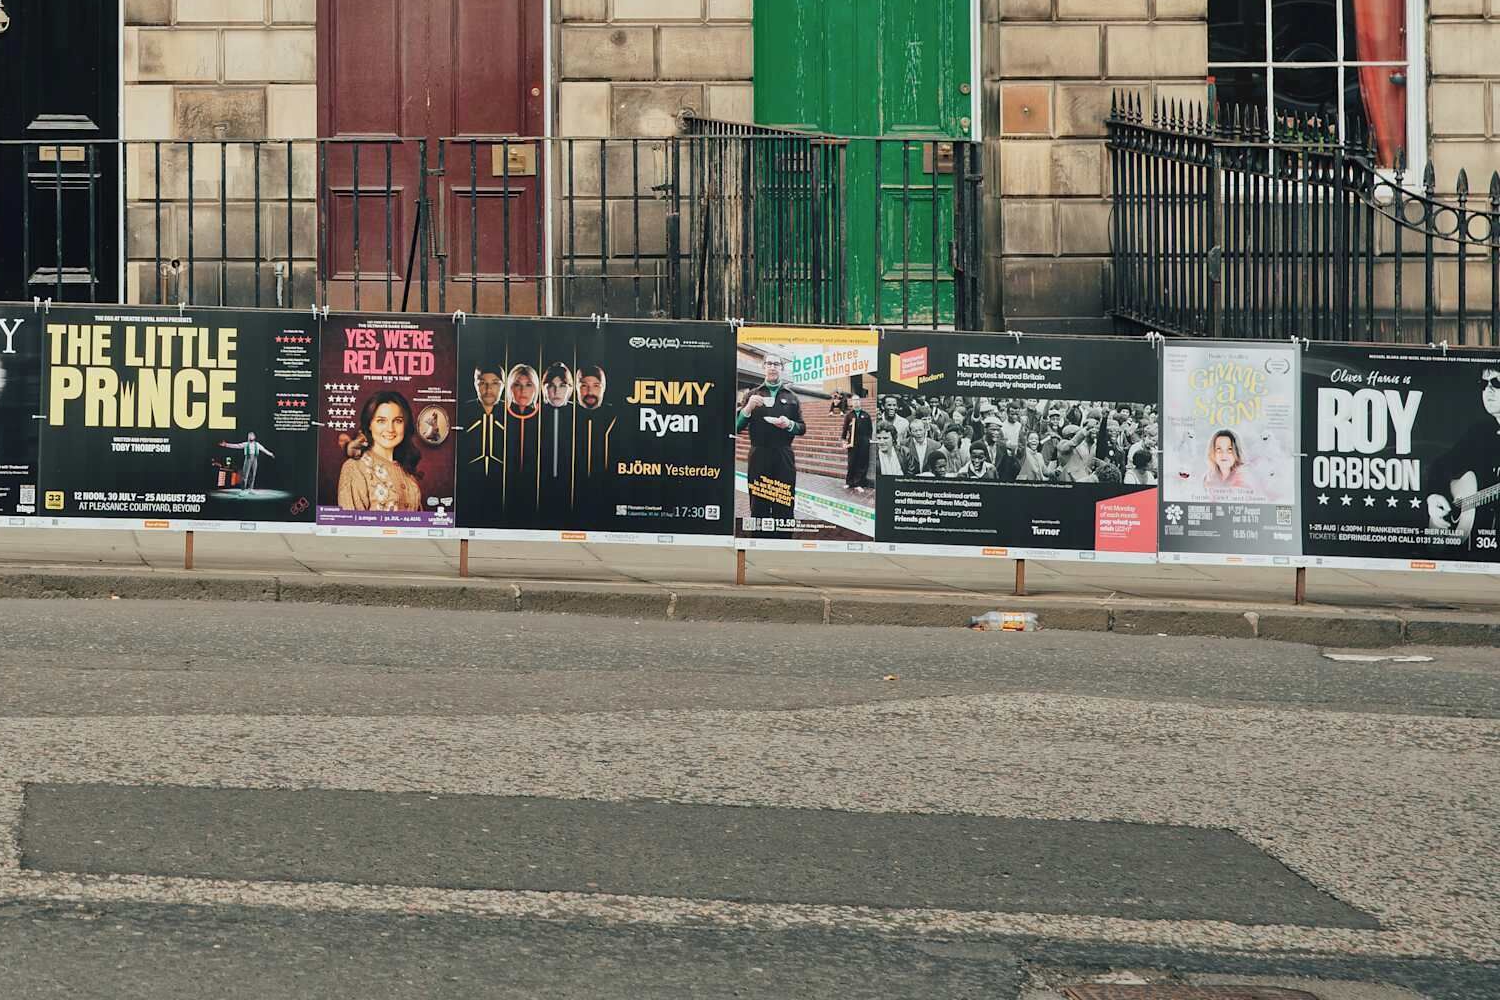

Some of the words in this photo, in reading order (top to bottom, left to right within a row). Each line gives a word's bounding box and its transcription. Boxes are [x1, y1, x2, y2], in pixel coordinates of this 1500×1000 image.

[47, 324, 111, 366] THE
[125, 326, 237, 368] LITTLE
[345, 329, 380, 350] YES,
[383, 330, 434, 350] WE'RE
[343, 350, 435, 376] RELATED
[793, 353, 824, 373] ben
[833, 349, 859, 361] three
[958, 353, 1062, 371] RESISTANCE
[793, 369, 825, 383] moor
[826, 363, 850, 377] thing
[852, 359, 869, 373] day
[957, 370, 973, 378] How
[998, 372, 1021, 380] shaped
[1330, 368, 1363, 383] Oliver
[1365, 371, 1400, 387] Harris
[1402, 374, 1411, 385] is
[970, 380, 1011, 389] photography
[1012, 381, 1036, 389] shaped
[1037, 382, 1062, 390] protest
[50, 366, 237, 430] PRINCE
[640, 407, 699, 437] Ryan
[1317, 387, 1424, 455] ROY
[111, 443, 131, 452] TOBY
[131, 443, 171, 453] THOMPSON
[617, 460, 661, 475] BJÖRN
[664, 464, 721, 479] Yesterday
[1312, 456, 1421, 492] ORBISON
[74, 492, 82, 500] 12
[83, 492, 106, 501] NOON,
[107, 492, 118, 501] 30
[118, 493, 136, 501] JULY
[145, 493, 155, 501] 25
[156, 494, 186, 503] AUGUST
[186, 494, 206, 503] 2025
[895, 490, 925, 498] Conceived
[79, 502, 88, 511] AT
[88, 502, 129, 512] PLEASANCE
[130, 503, 172, 513] COURTYARD,
[172, 503, 201, 513] BEYOND
[675, 506, 705, 518] 17:30
[939, 509, 961, 518] January
[1032, 526, 1060, 536] Turner
[1367, 526, 1420, 535] FRANKENSTEIN'S
[1309, 532, 1336, 540] TICKETS:
[1339, 534, 1387, 542] EDFRINGE.COM
[1432, 537, 1445, 545] 226
[1476, 536, 1498, 549] 304
